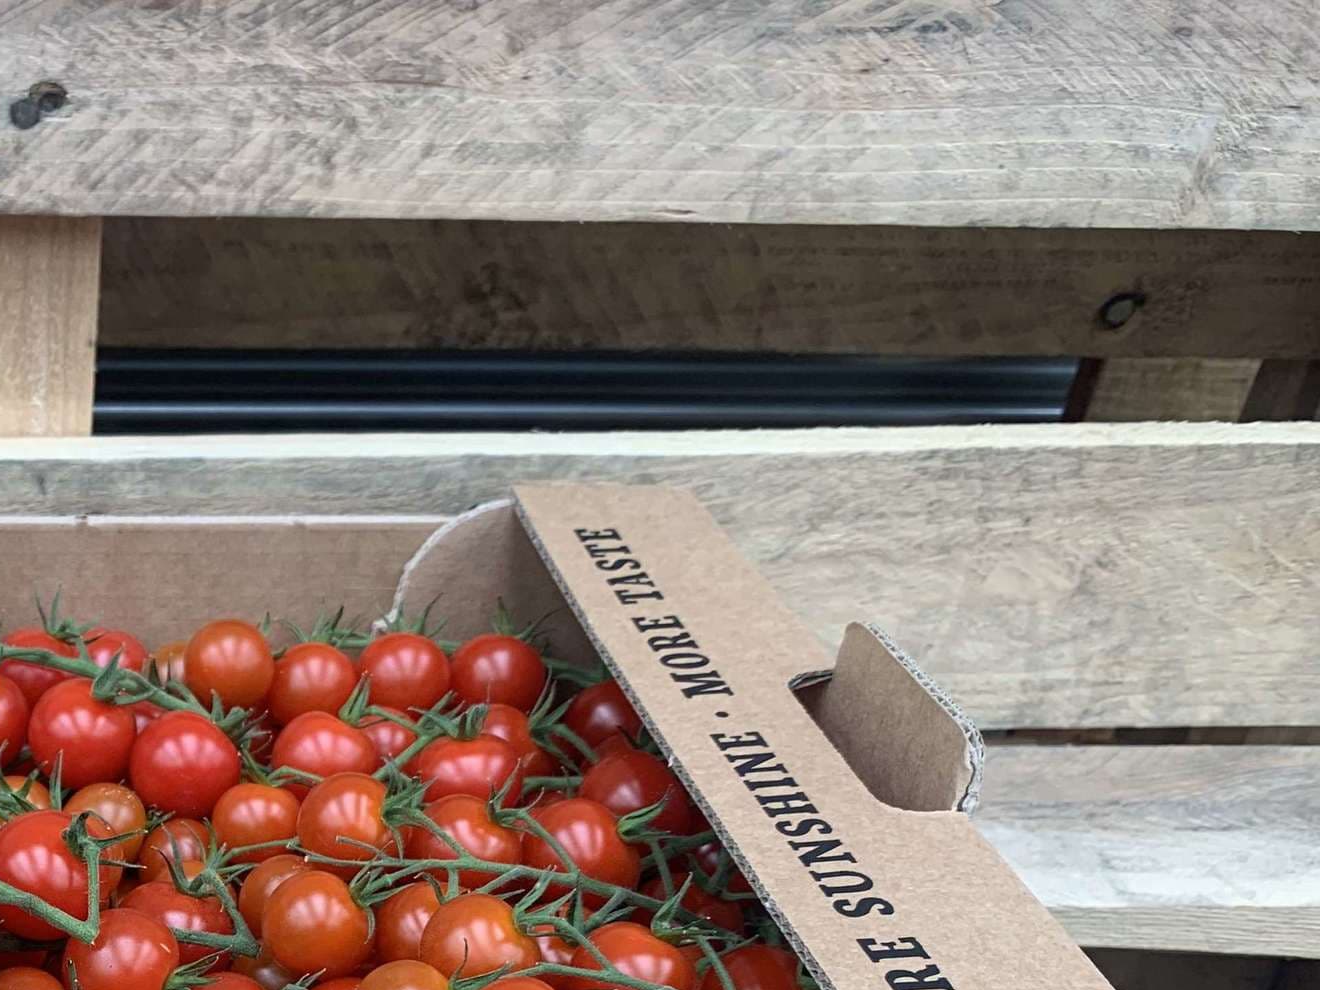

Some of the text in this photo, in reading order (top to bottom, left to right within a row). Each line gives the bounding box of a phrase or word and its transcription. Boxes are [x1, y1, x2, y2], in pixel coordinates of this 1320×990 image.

[574, 528, 665, 606] TASTE
[631, 615, 735, 700] MORE
[709, 730, 896, 919] SUNSHINE
